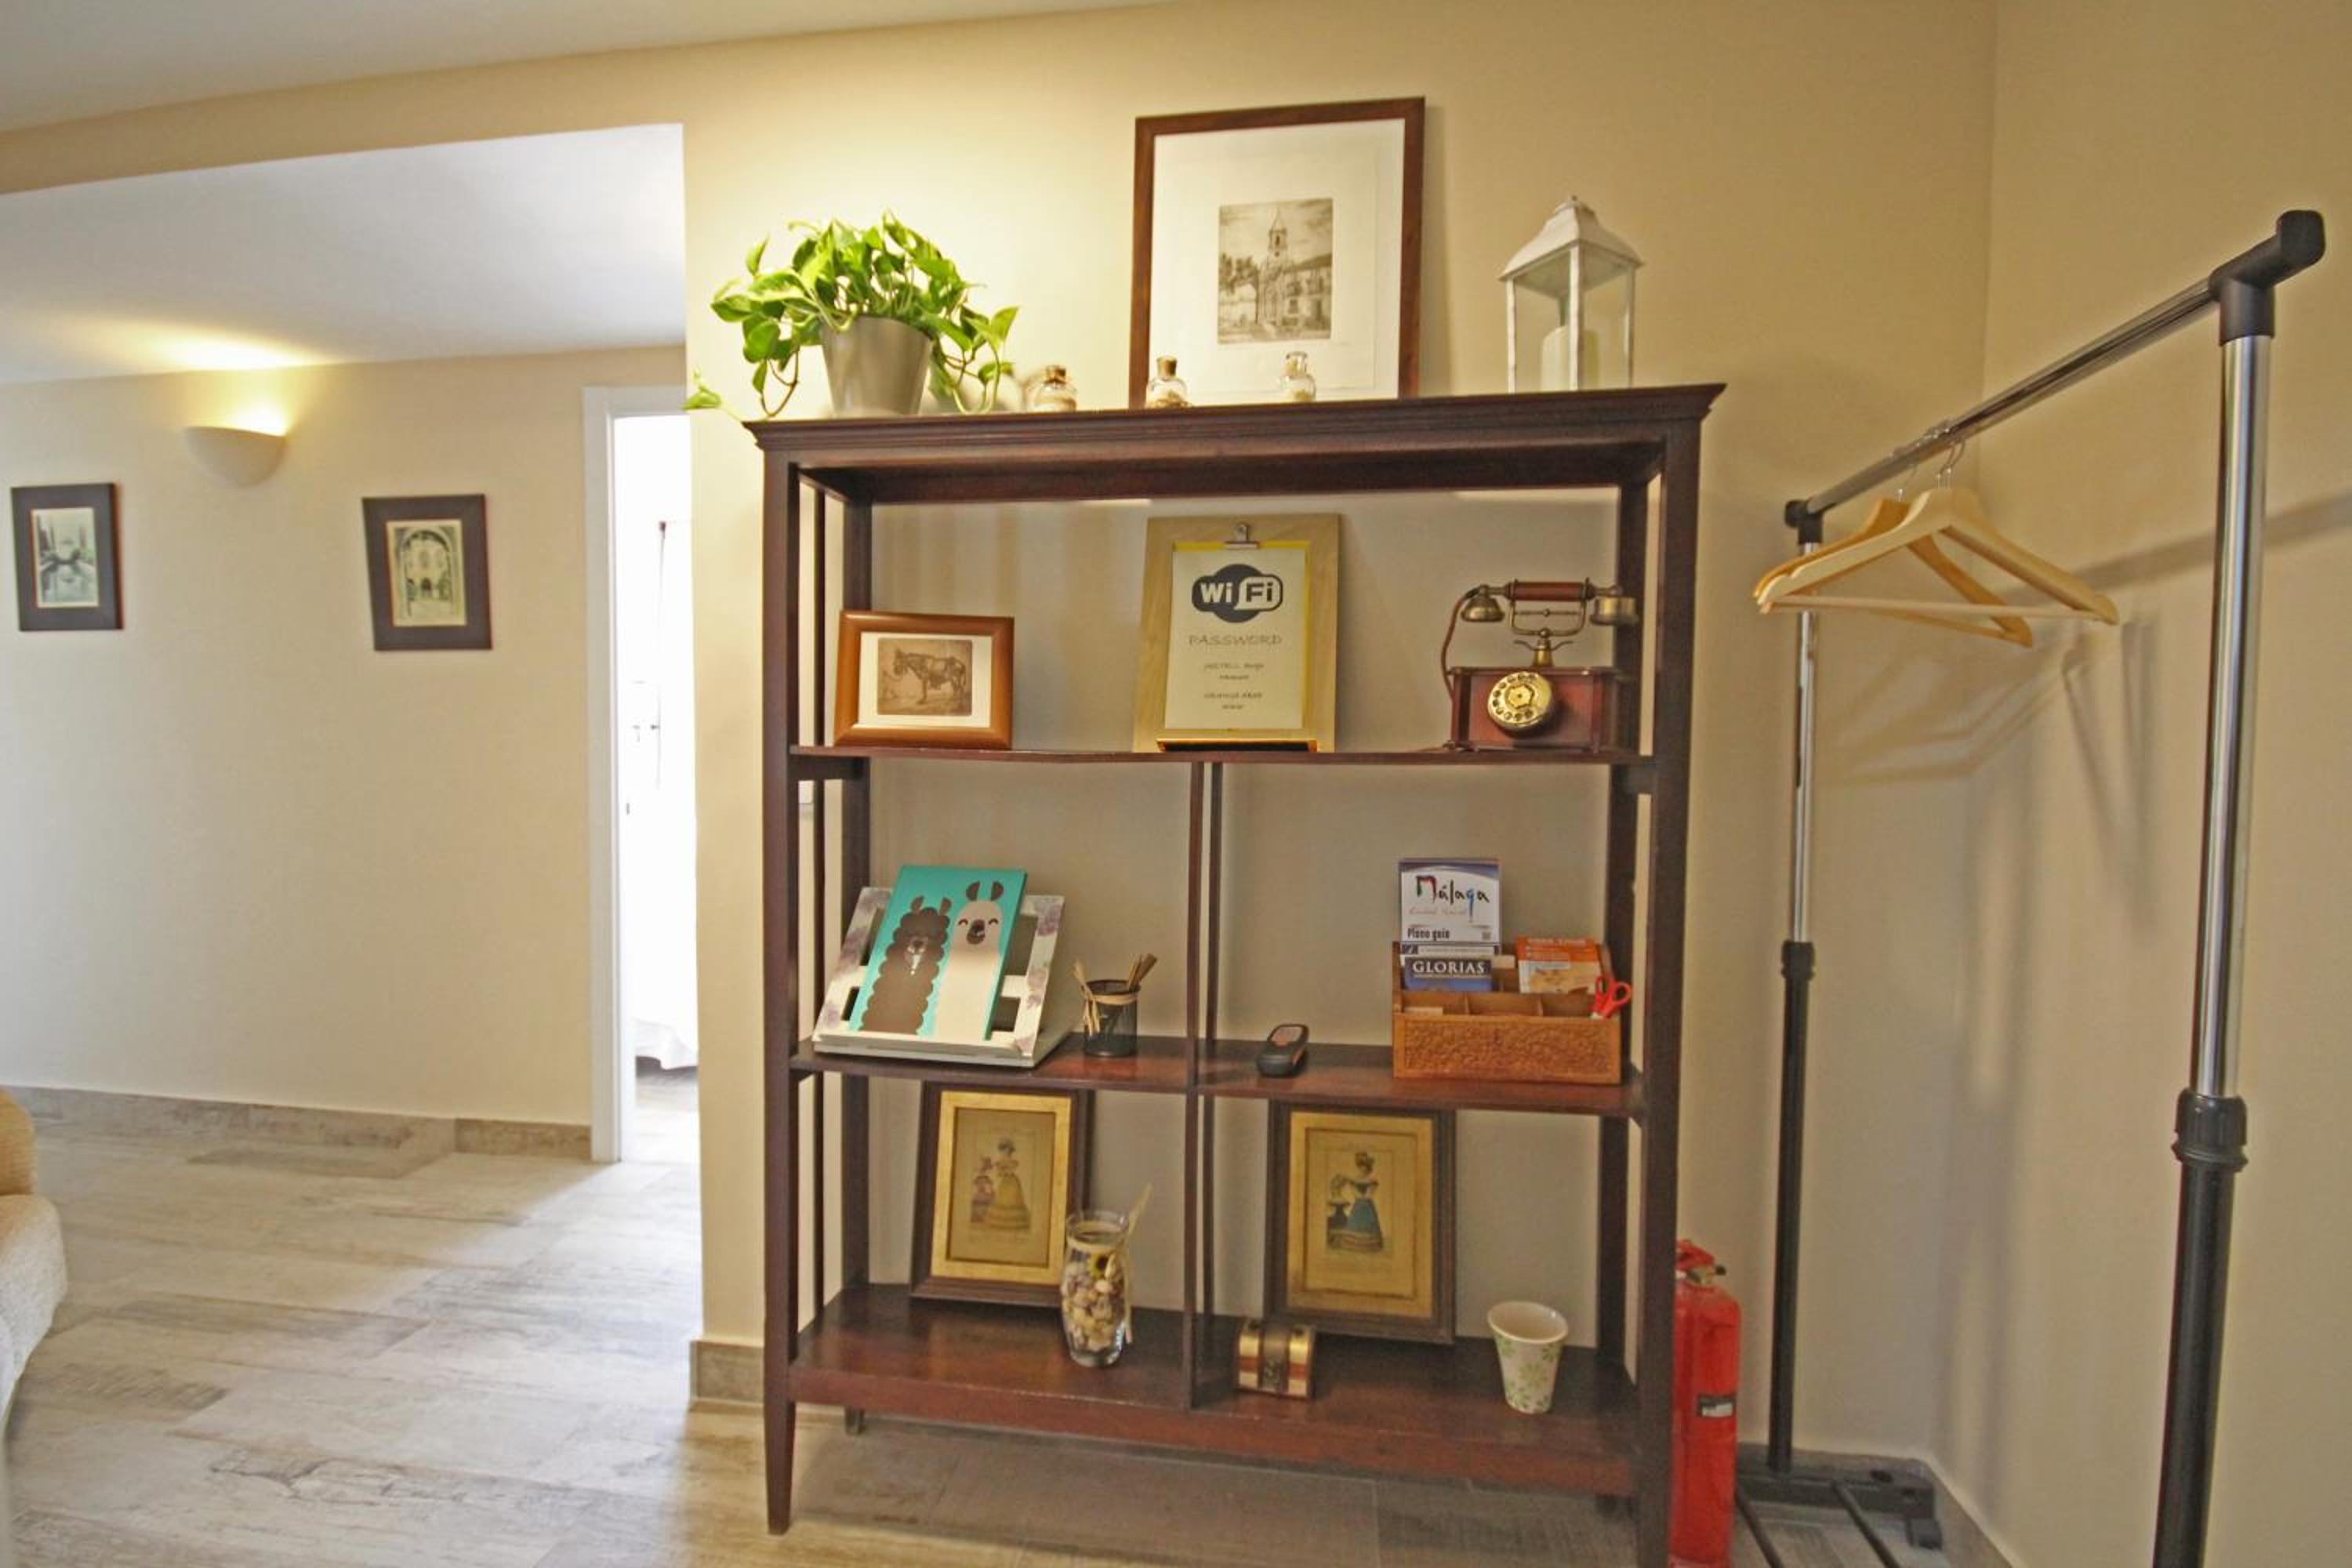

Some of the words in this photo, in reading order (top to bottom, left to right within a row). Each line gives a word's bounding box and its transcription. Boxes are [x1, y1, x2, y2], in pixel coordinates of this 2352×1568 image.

[1189, 634, 1282, 646] PASSWORD
[1415, 875, 1490, 923] Málaga
[1407, 927, 1430, 938] Plano
[1413, 960, 1485, 974] GLORIAS
